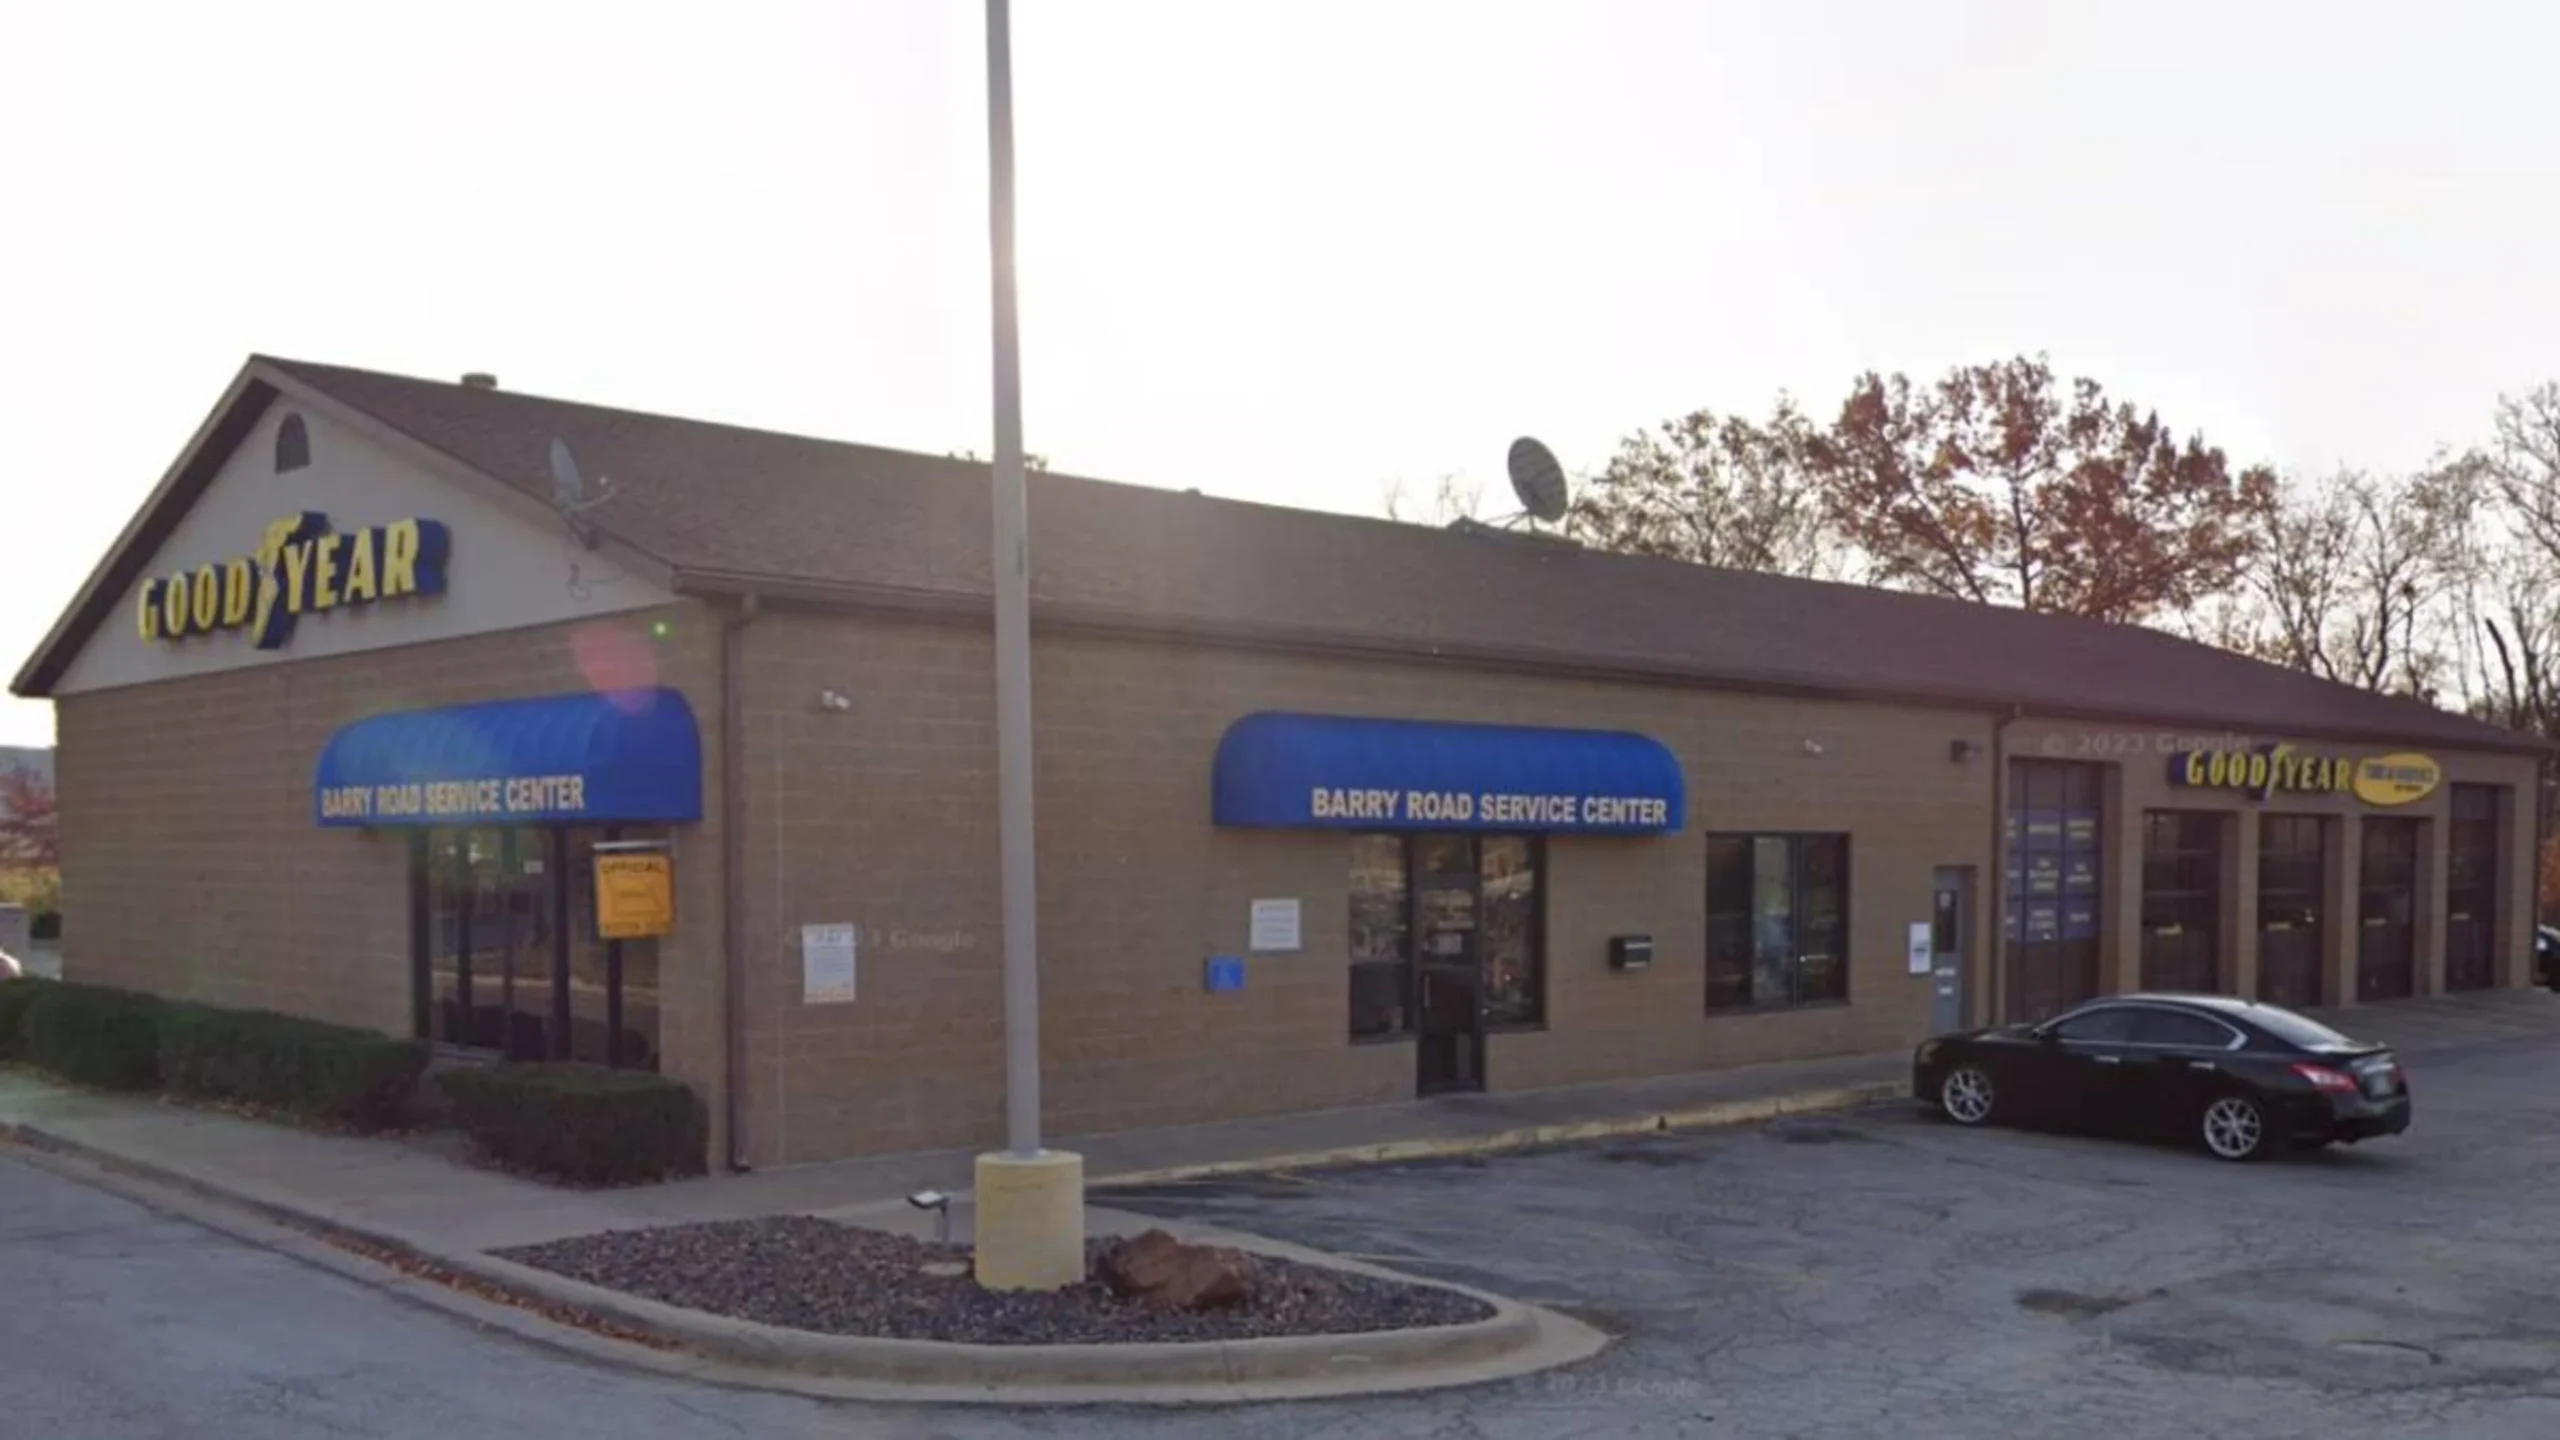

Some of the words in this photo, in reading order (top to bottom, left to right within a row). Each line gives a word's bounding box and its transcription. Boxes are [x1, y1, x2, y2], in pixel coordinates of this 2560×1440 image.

[137, 512, 420, 643] GOODYEAR
[321, 787, 373, 817] BARRY
[377, 783, 422, 815] ROAD
[424, 778, 501, 815] SERVICE
[505, 774, 585, 812] CENTER
[2185, 743, 2351, 800] GOODYEAR
[1311, 787, 1401, 819] BARRY
[1406, 791, 1474, 822] ROAD
[1479, 794, 1577, 824] SERVICE
[1582, 797, 1669, 826] CENTER
